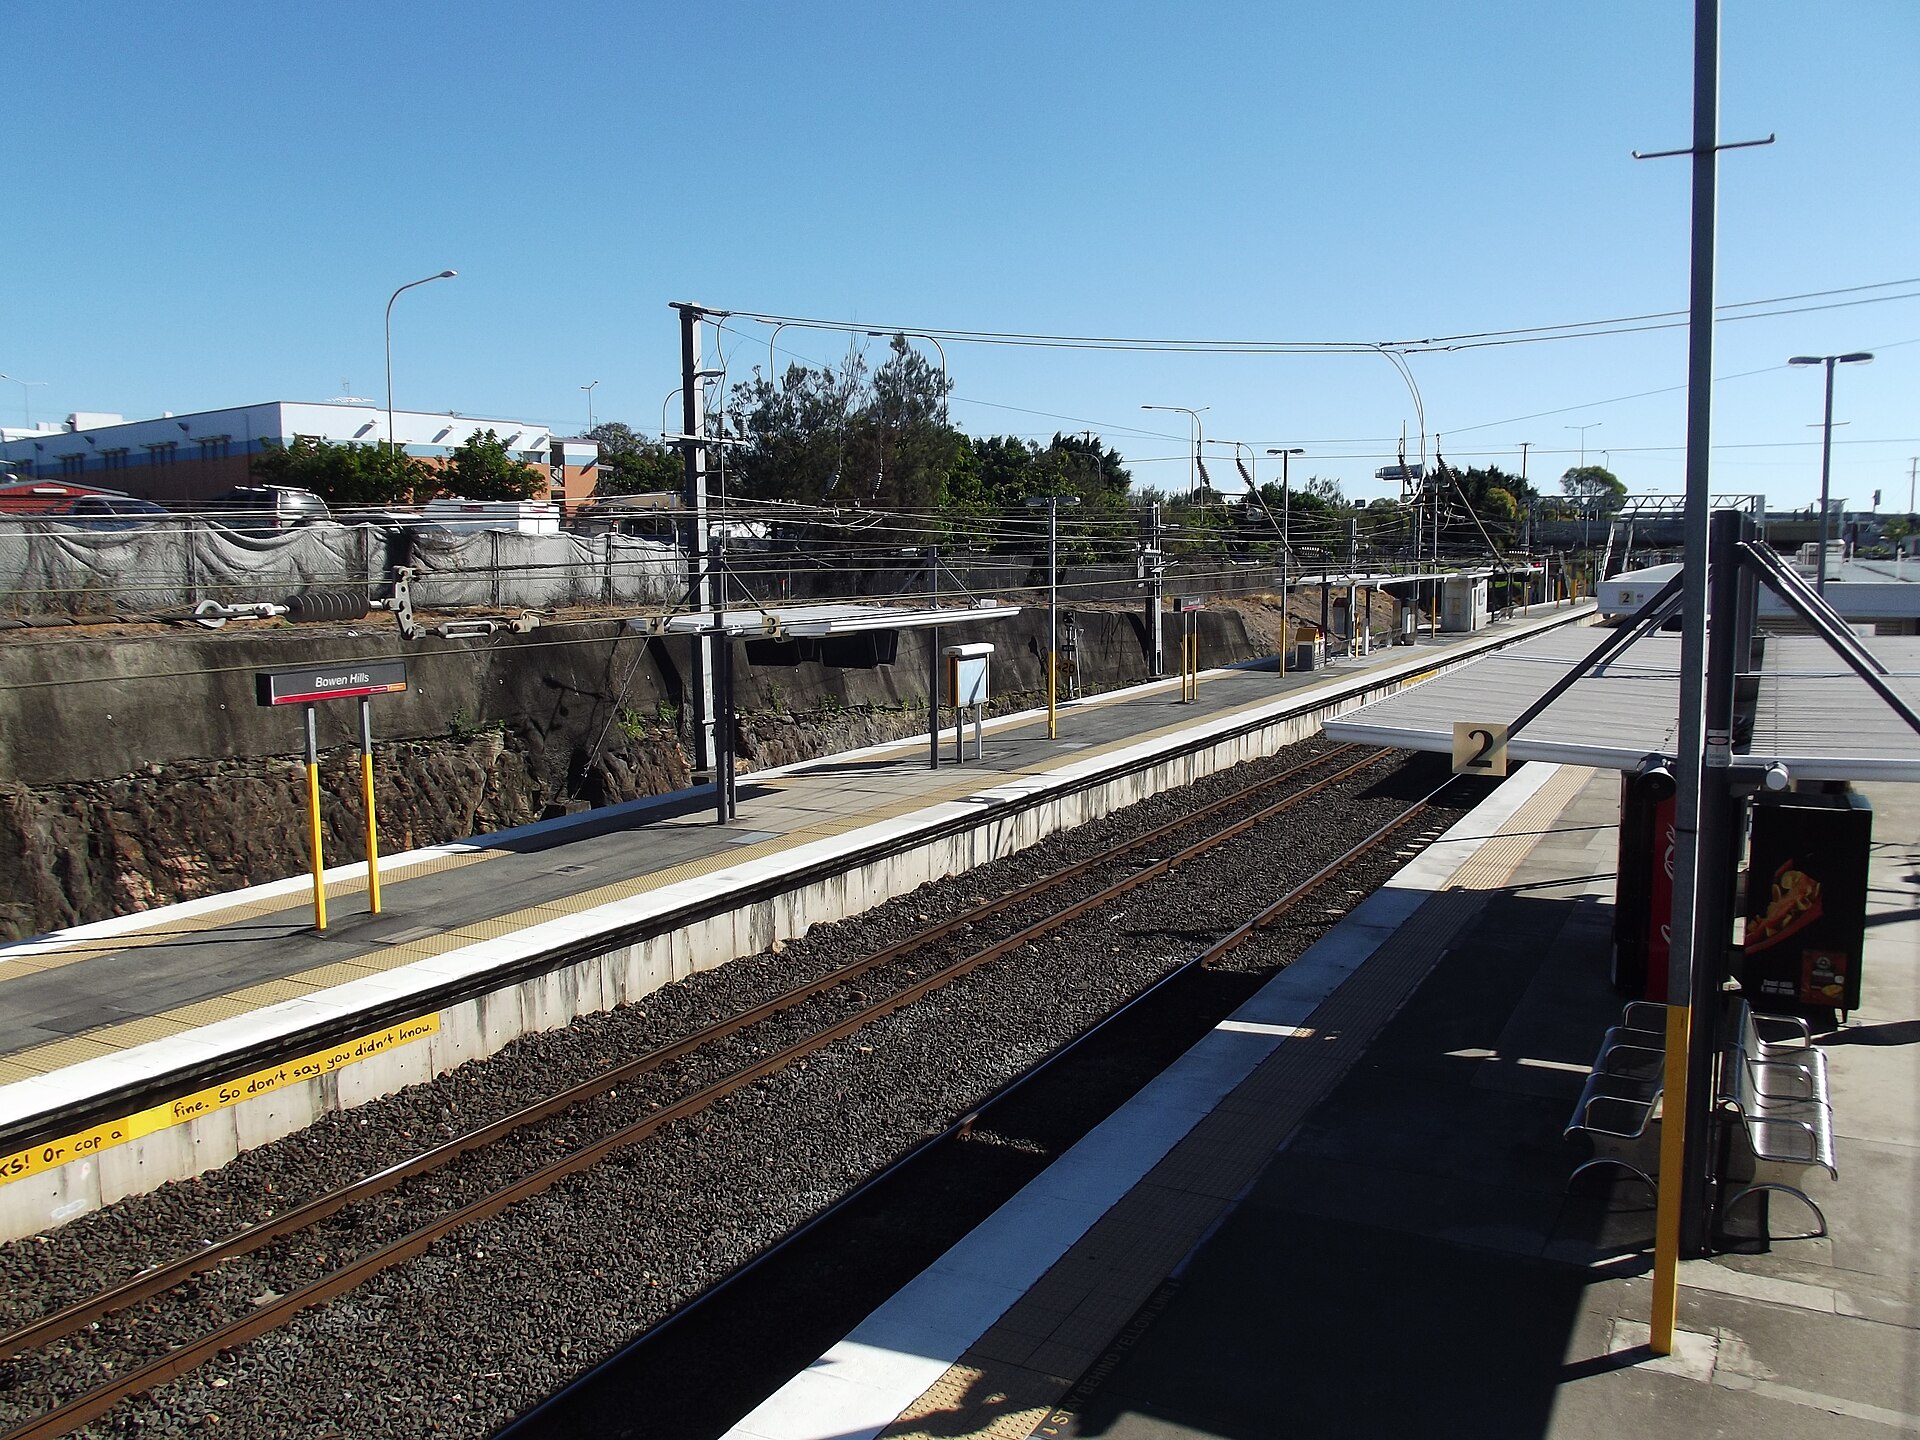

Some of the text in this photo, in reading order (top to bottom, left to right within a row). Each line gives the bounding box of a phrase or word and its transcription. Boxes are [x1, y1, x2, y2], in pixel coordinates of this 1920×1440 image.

[1621, 592, 1631, 604] 2
[766, 617, 777, 635] 3
[315, 672, 370, 688] Bowen Hills
[1466, 729, 1494, 769] 2
[43, 1148, 66, 1163] Or
[74, 1136, 102, 1152] cop
[111, 1131, 123, 1139] a
[173, 1102, 209, 1118] fine.
[218, 1088, 241, 1104] So
[247, 1071, 287, 1094] don't
[293, 1062, 321, 1078] say
[327, 1051, 351, 1069] you
[355, 1033, 394, 1057] didn't
[399, 1024, 433, 1041] know.
[1079, 1351, 1121, 1395] BEHIND
[1113, 1310, 1157, 1351] YELLOW
